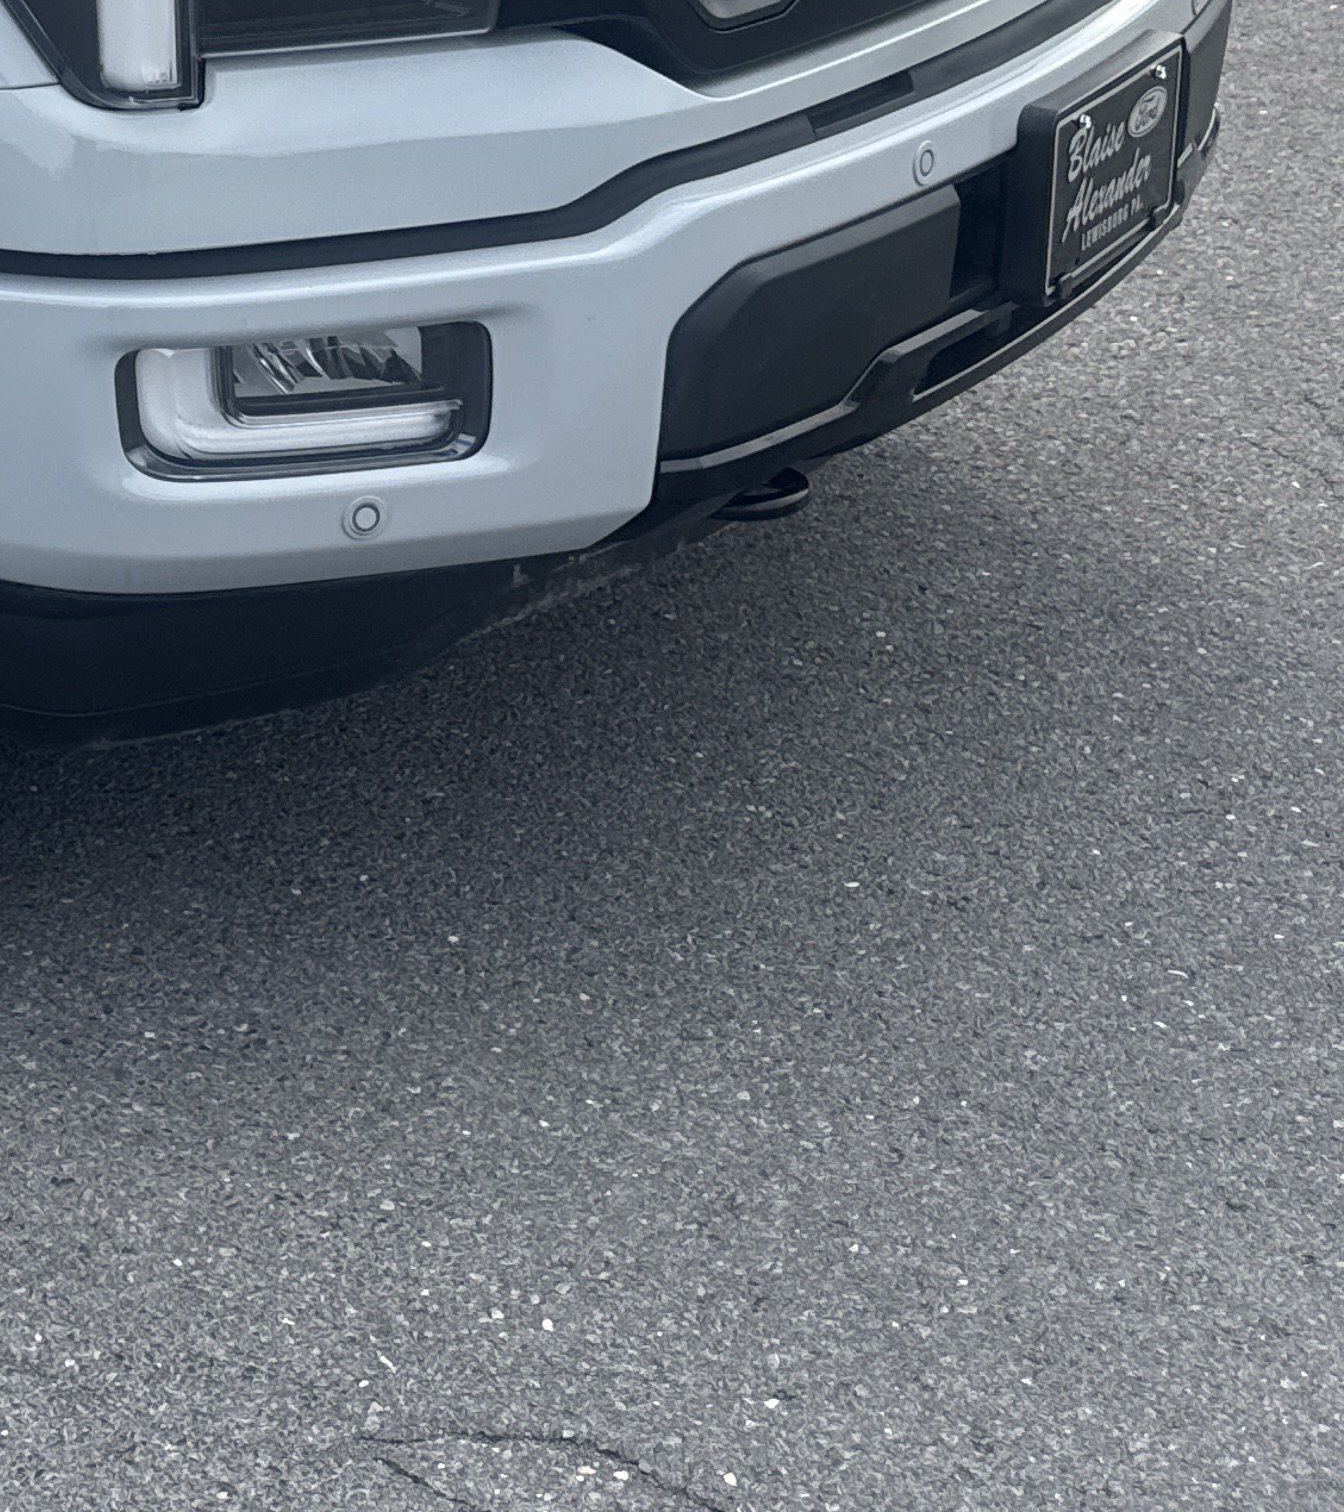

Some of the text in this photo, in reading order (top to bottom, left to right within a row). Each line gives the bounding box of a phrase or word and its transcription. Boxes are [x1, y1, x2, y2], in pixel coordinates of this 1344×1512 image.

[1068, 120, 1126, 182] Blaise
[1061, 147, 1151, 243] Alexander
[1081, 203, 1130, 251] LEWISBURG
